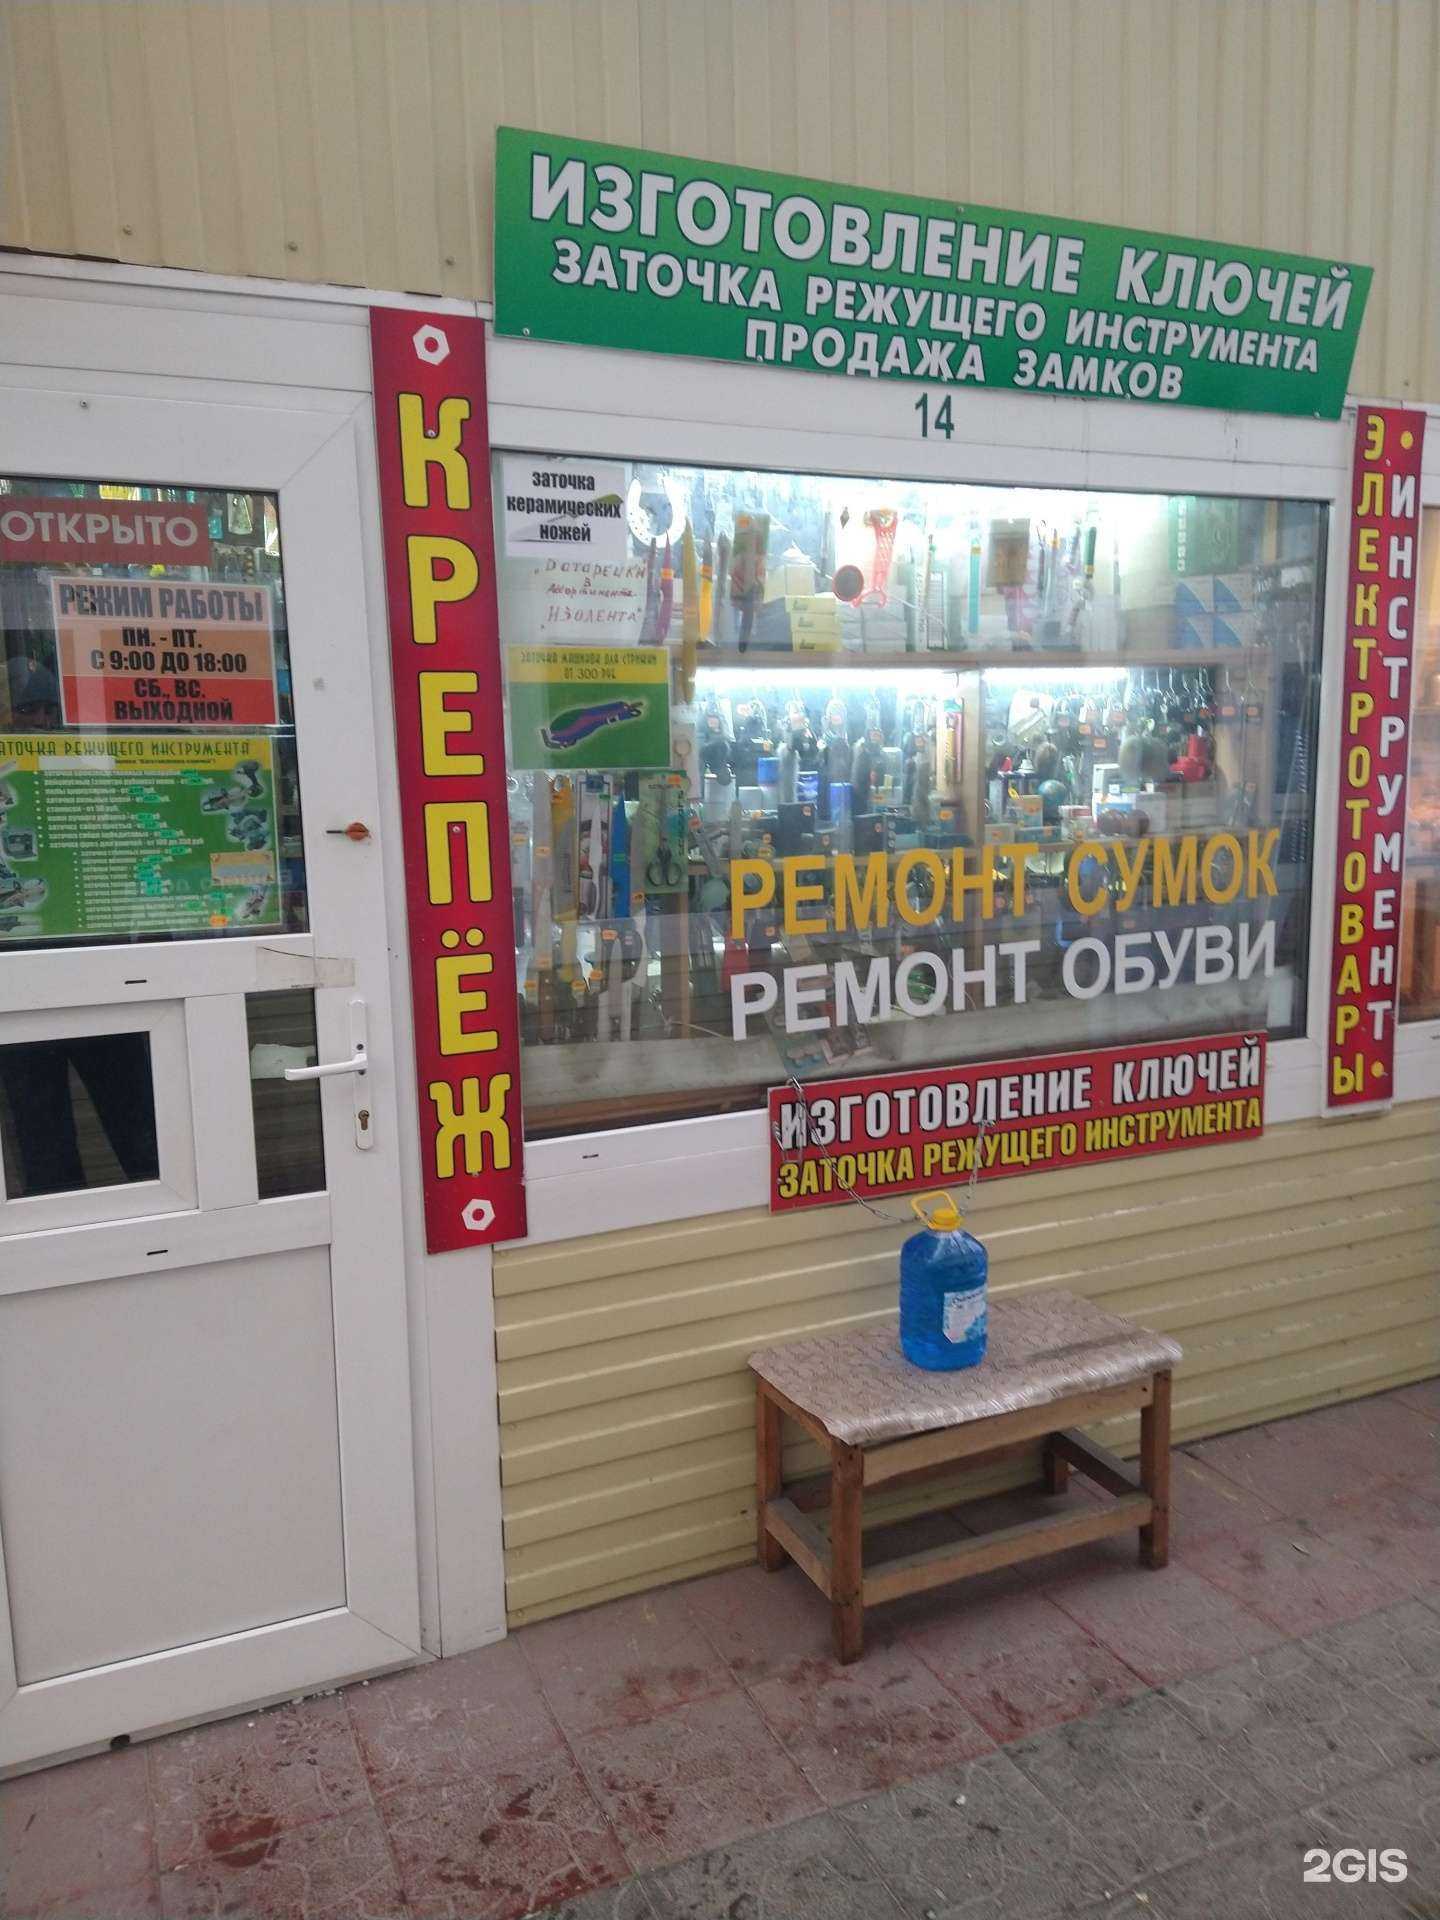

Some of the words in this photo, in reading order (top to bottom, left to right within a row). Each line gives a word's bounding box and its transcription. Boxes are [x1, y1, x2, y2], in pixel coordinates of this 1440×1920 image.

[530, 153, 1085, 297] ИЗГОТОВЛЕНИЕ
[1115, 245, 1353, 331] КЛЮЧЕЙ
[551, 237, 782, 312] ЗАТОЧКА
[804, 275, 1047, 342] РЕЖУЩЕГО
[1065, 307, 1319, 374] ИНСТРУМЕНТА
[745, 318, 986, 384] ПРОДАЖА
[1012, 349, 1183, 401] ЗАМКОВ
[914, 391, 955, 440] 14
[532, 470, 595, 492] заточка
[0, 510, 199, 547] ОТКРЫТО
[506, 495, 622, 519] керамических
[539, 521, 591, 543] ножей
[59, 583, 153, 618] РЕЖИМ
[159, 587, 264, 622] РАБОТЫ
[91, 649, 105, 670] С
[109, 650, 155, 671] 9:00
[160, 652, 190, 674] ДО
[195, 653, 247, 673] 18:00
[122, 626, 155, 647] ПН.
[171, 628, 203, 649] ПТ.
[114, 698, 233, 723] ВЫХОДНОЙ
[174, 680, 206, 699] ВС.
[0, 741, 56, 756] АТОЧКА
[151, 742, 250, 756] ИНСТРУМЕНТА
[1332, 415, 1386, 1096] ЭЛЕКТРОТОВАРЫ
[1367, 473, 1416, 1042] ИНСТРУМЕНТ
[397, 391, 512, 1180] КРЕПЁЖ
[728, 842, 1040, 939] РЕМОНТ
[1067, 828, 1281, 916] СУМОК
[730, 939, 1041, 1041] РЕМОНТ
[1062, 919, 1277, 1000] ОБУВИ
[781, 1066, 1092, 1150] ИЗГОТОВЛЕНИЕ
[1113, 1035, 1261, 1104] КЛЮЧЕЙ
[778, 1146, 915, 1199] ЗАТОЧКА
[923, 1123, 1078, 1178] РЕЖУЩЕГО
[1085, 1098, 1262, 1152] ИНСТРУМЕНТА
